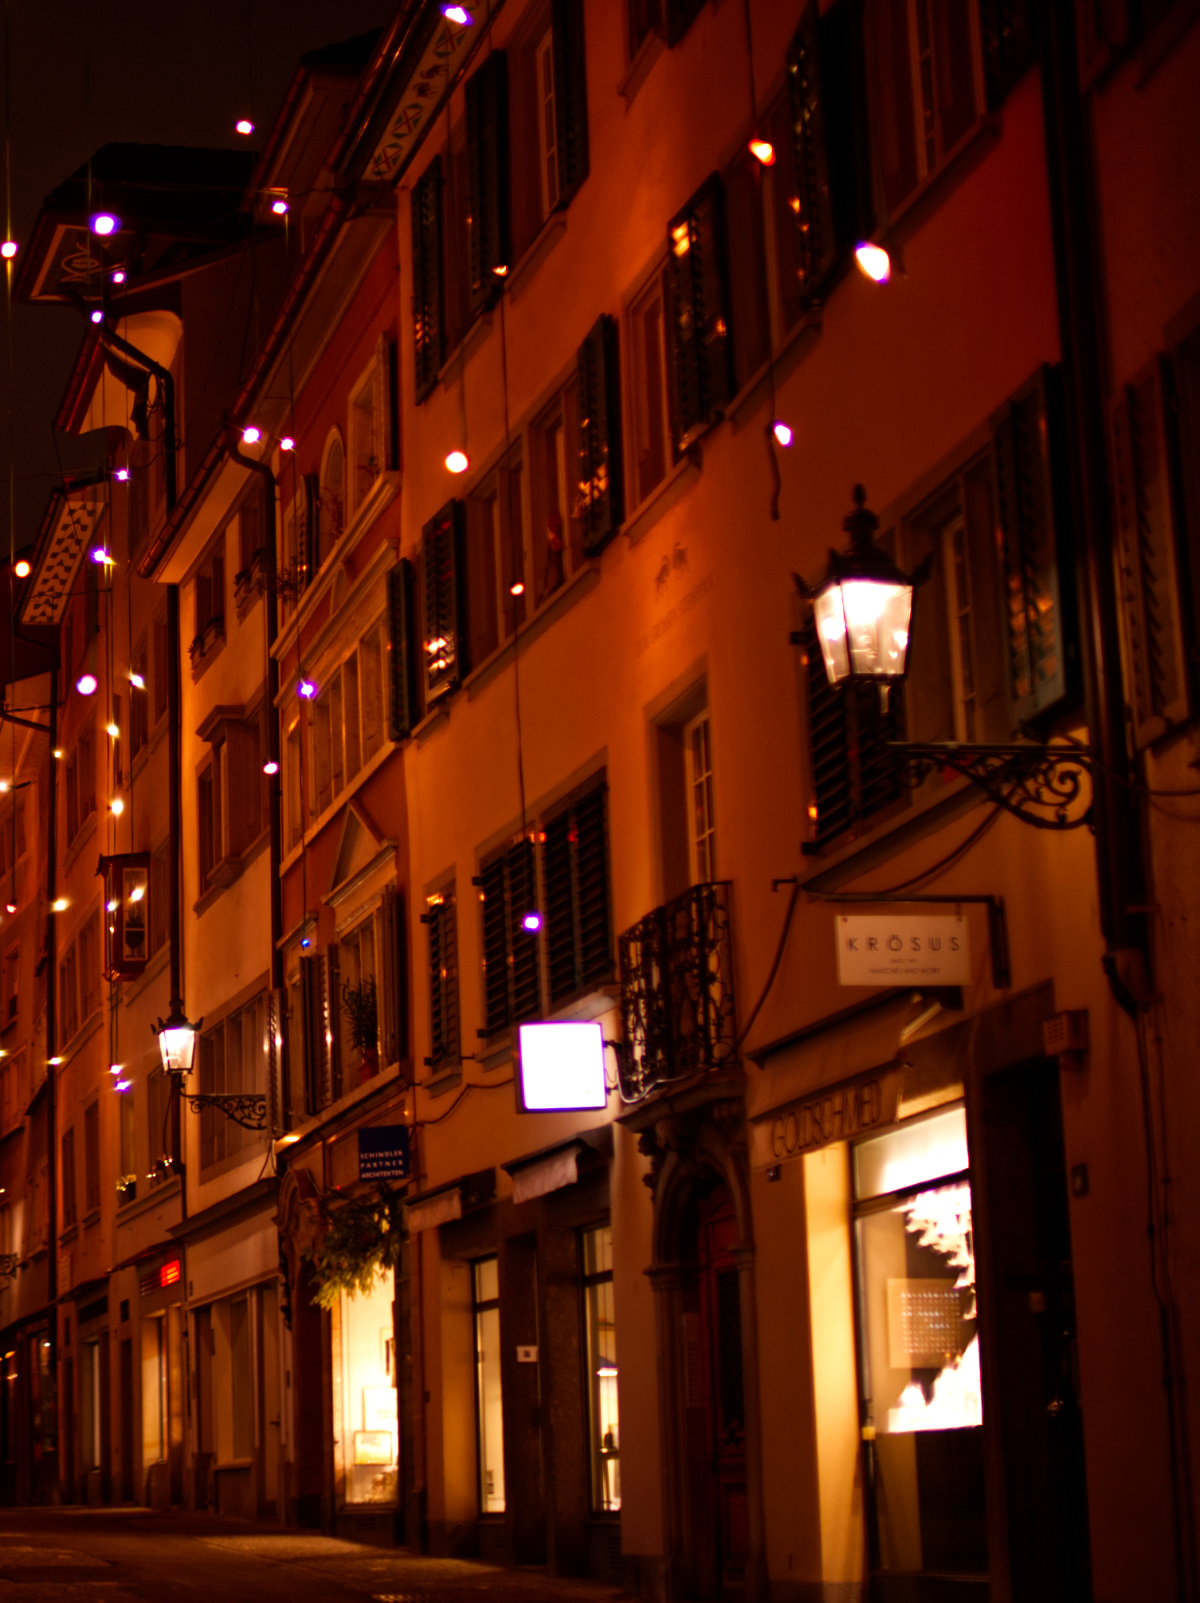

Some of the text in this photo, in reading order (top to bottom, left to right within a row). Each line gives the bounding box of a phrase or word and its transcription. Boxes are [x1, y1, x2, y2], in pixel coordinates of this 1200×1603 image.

[847, 934, 960, 952] KRÖSUS
[772, 1080, 881, 1157] GOLDSCHMIED
[360, 1150, 403, 1160] SCHINDLER
[360, 1160, 404, 1169] PARTNER
[361, 1169, 404, 1179] ARCHITEKTEN
